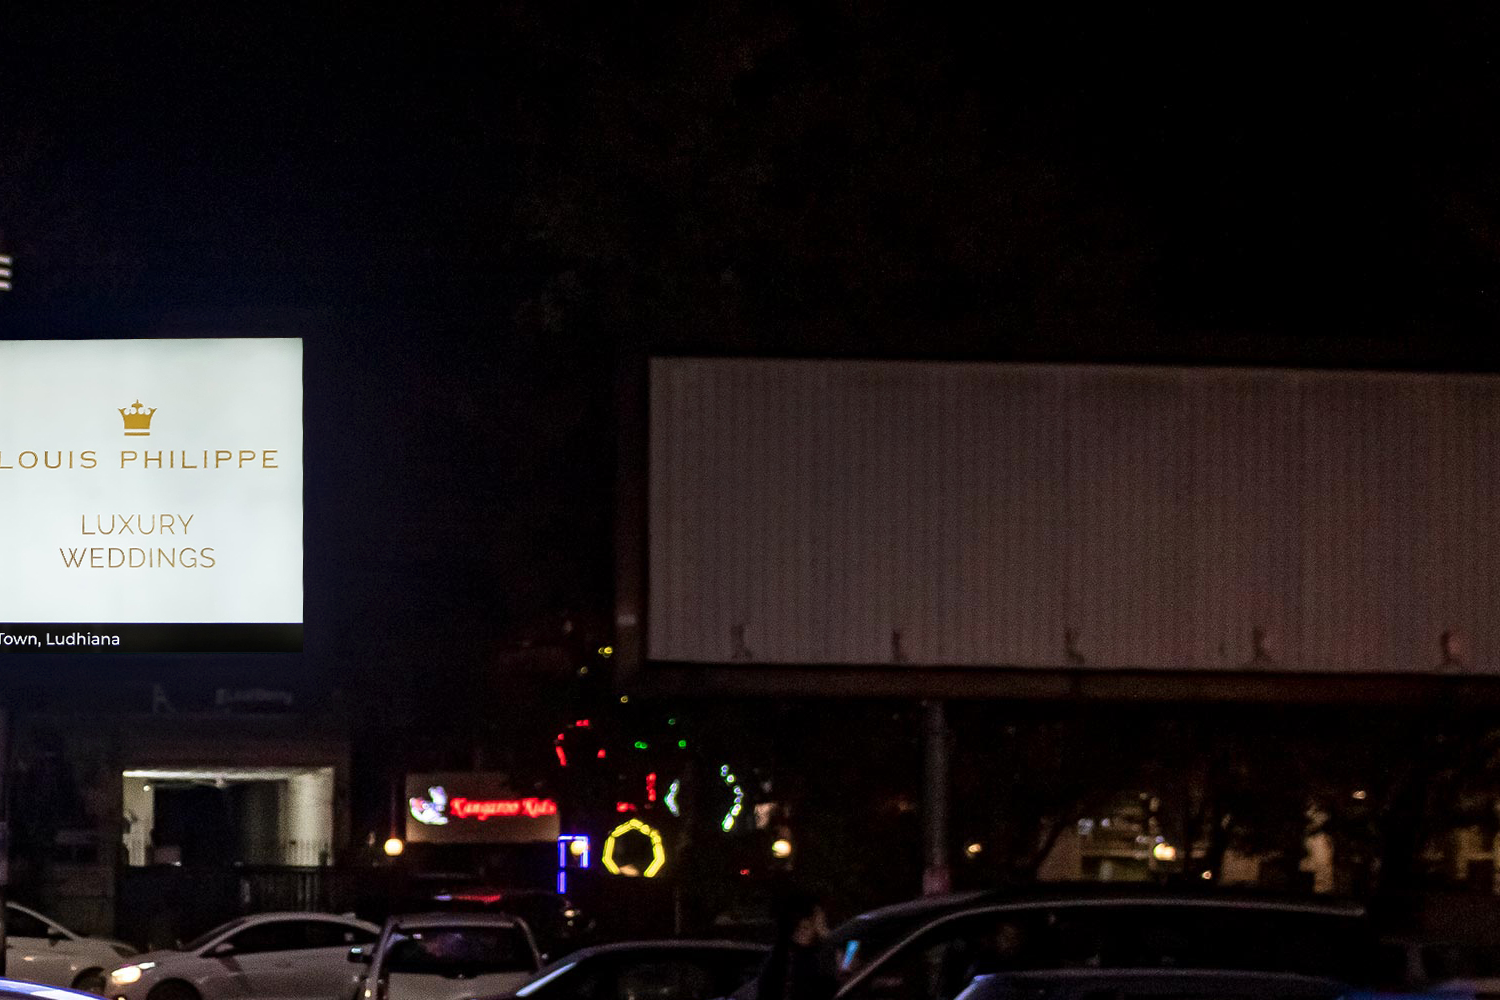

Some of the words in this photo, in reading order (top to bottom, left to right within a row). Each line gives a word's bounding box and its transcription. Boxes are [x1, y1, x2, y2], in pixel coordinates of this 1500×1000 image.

[120, 448, 279, 469] PHILIPPE
[81, 513, 194, 535] LUXURY
[59, 547, 216, 569] WEDDINGS
[46, 631, 120, 645] Ludhiana
